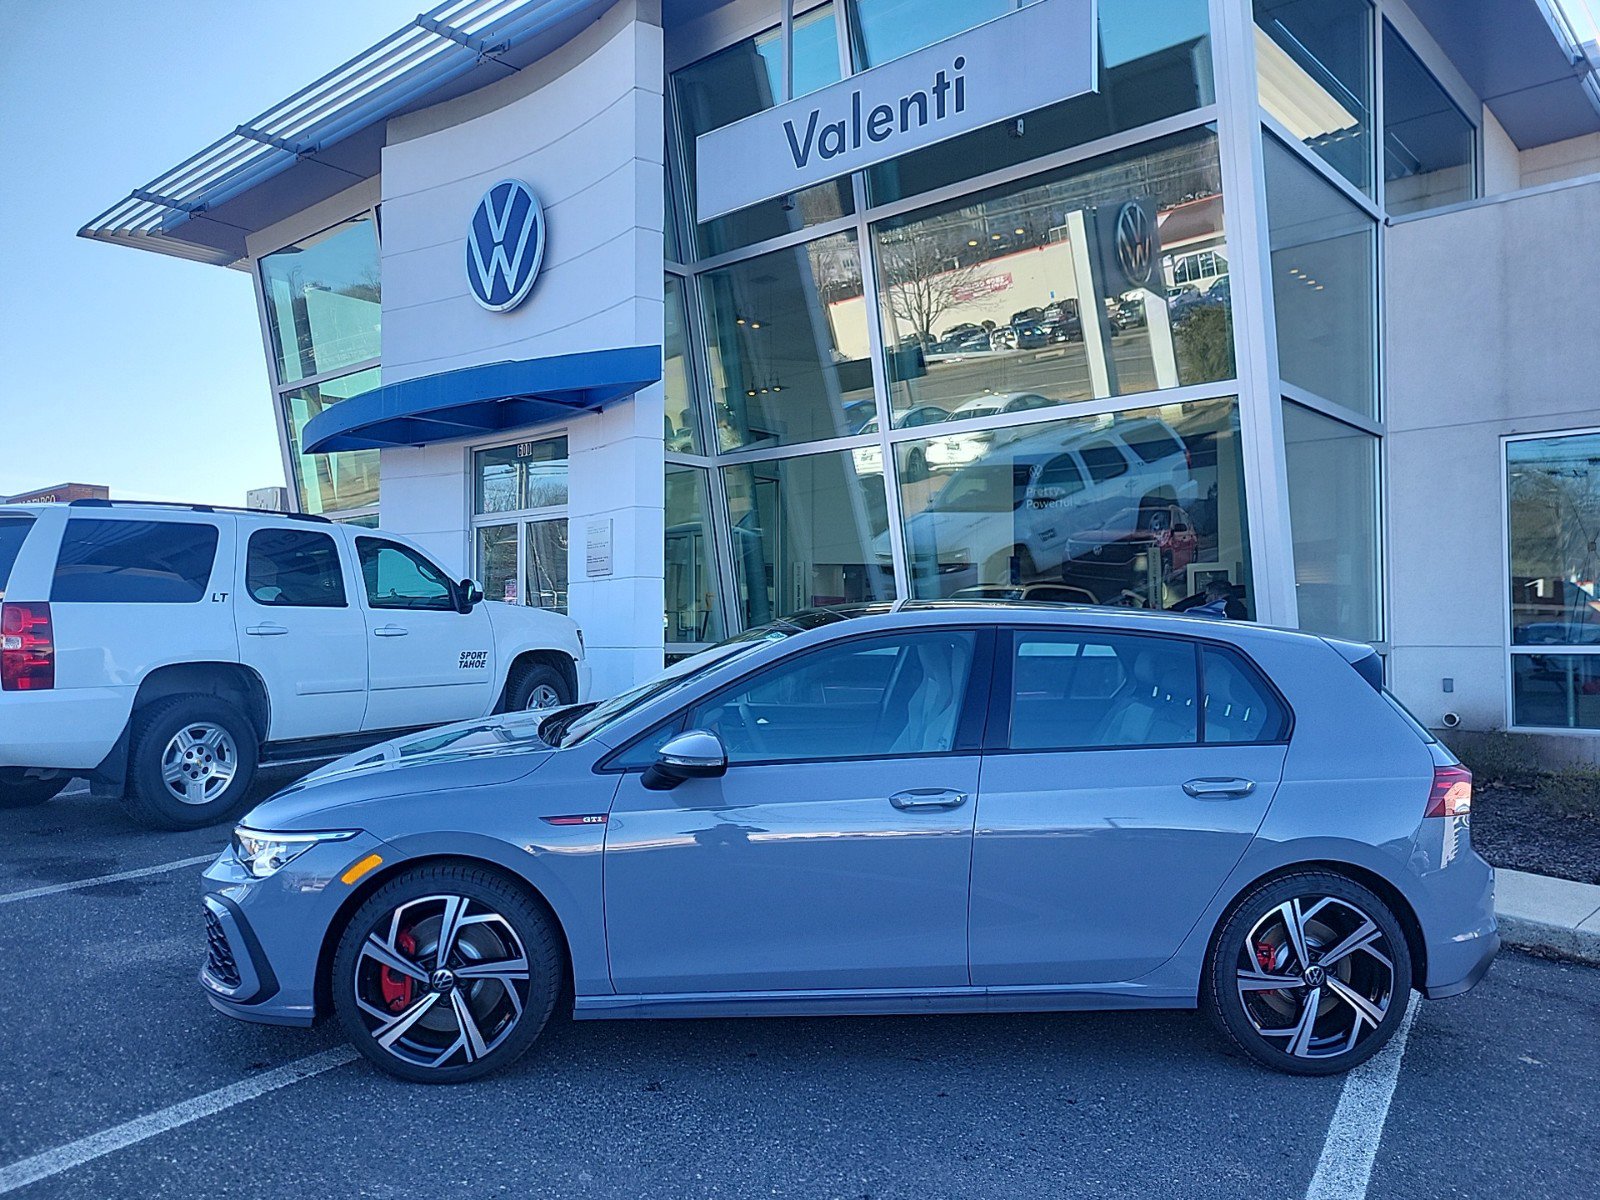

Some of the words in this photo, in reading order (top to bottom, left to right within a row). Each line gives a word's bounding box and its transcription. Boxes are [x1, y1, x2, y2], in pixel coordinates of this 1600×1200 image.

[784, 55, 967, 169] Valenti
[466, 178, 546, 313] VW
[1026, 497, 1073, 509] Powerful
[212, 592, 228, 602] LT
[460, 651, 488, 660] SPORT
[458, 660, 487, 669] TAHOE
